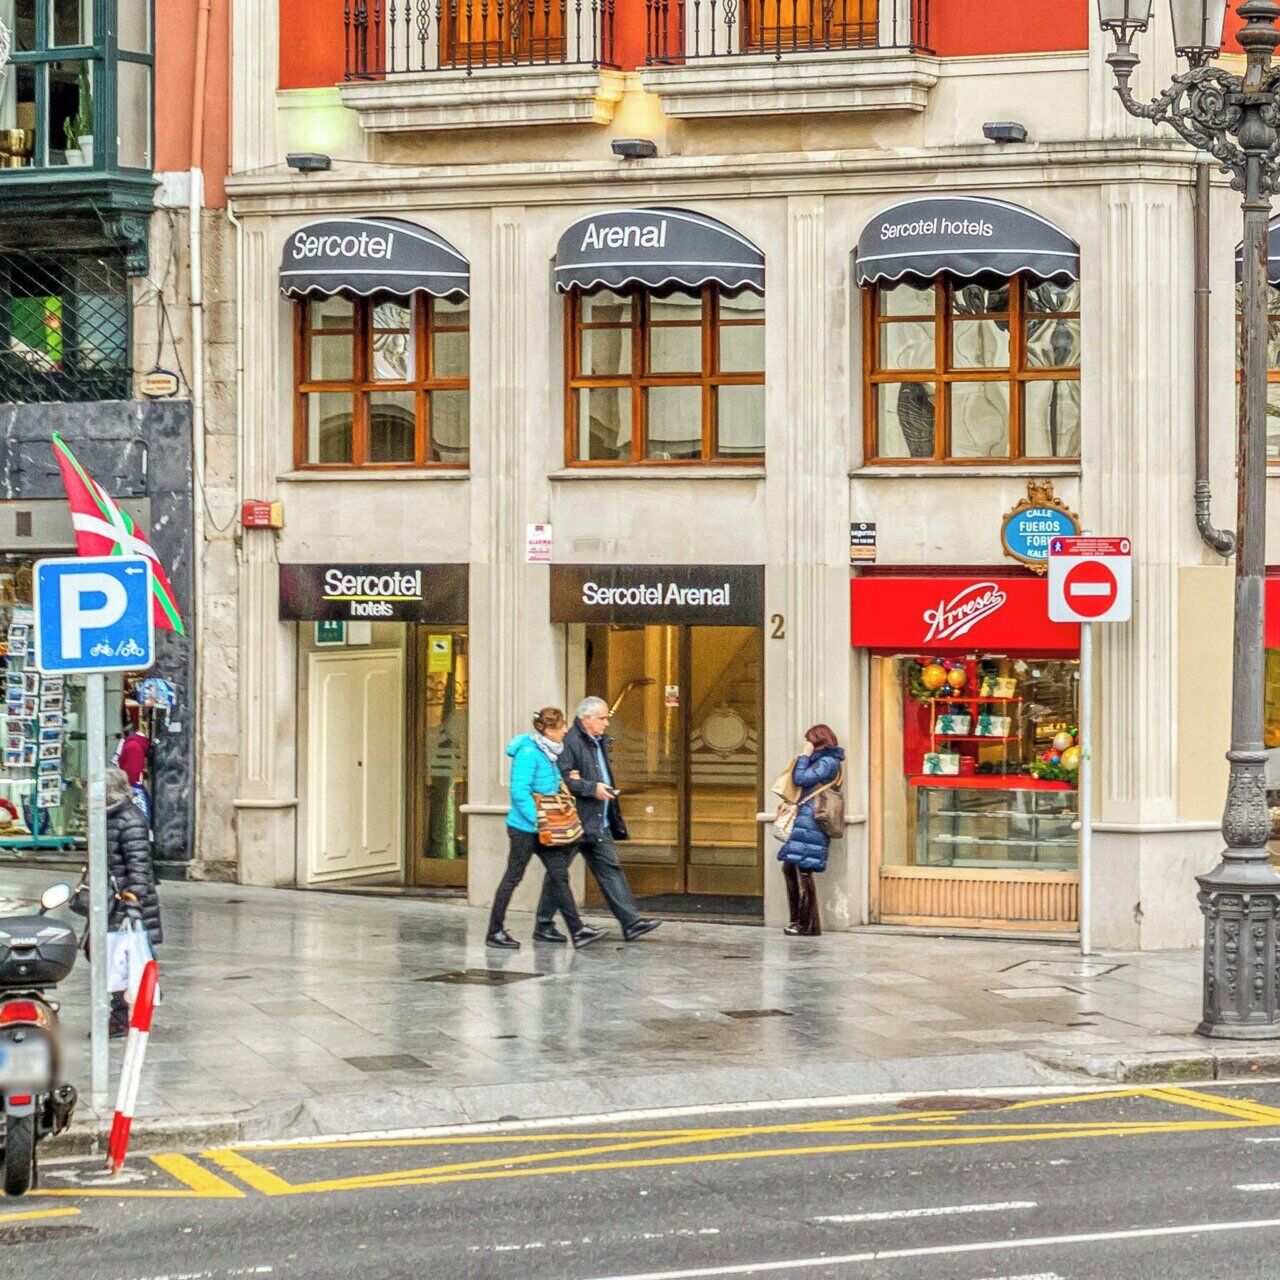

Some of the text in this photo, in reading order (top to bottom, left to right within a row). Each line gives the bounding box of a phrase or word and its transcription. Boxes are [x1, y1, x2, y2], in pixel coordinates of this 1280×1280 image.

[580, 219, 667, 251] Arenal
[880, 218, 994, 241] Sercotel hotels
[291, 230, 394, 260] Sercotel
[1019, 521, 1061, 532] FUEROS
[1026, 509, 1053, 518] CALLE
[1027, 549, 1049, 558] KALE
[324, 569, 422, 596] Sercotel
[582, 582, 730, 607] Sercotel Arenal
[59, 572, 128, 659] P
[350, 601, 394, 617] hotels
[922, 582, 1007, 643] Arrese
[770, 613, 786, 640] 2
